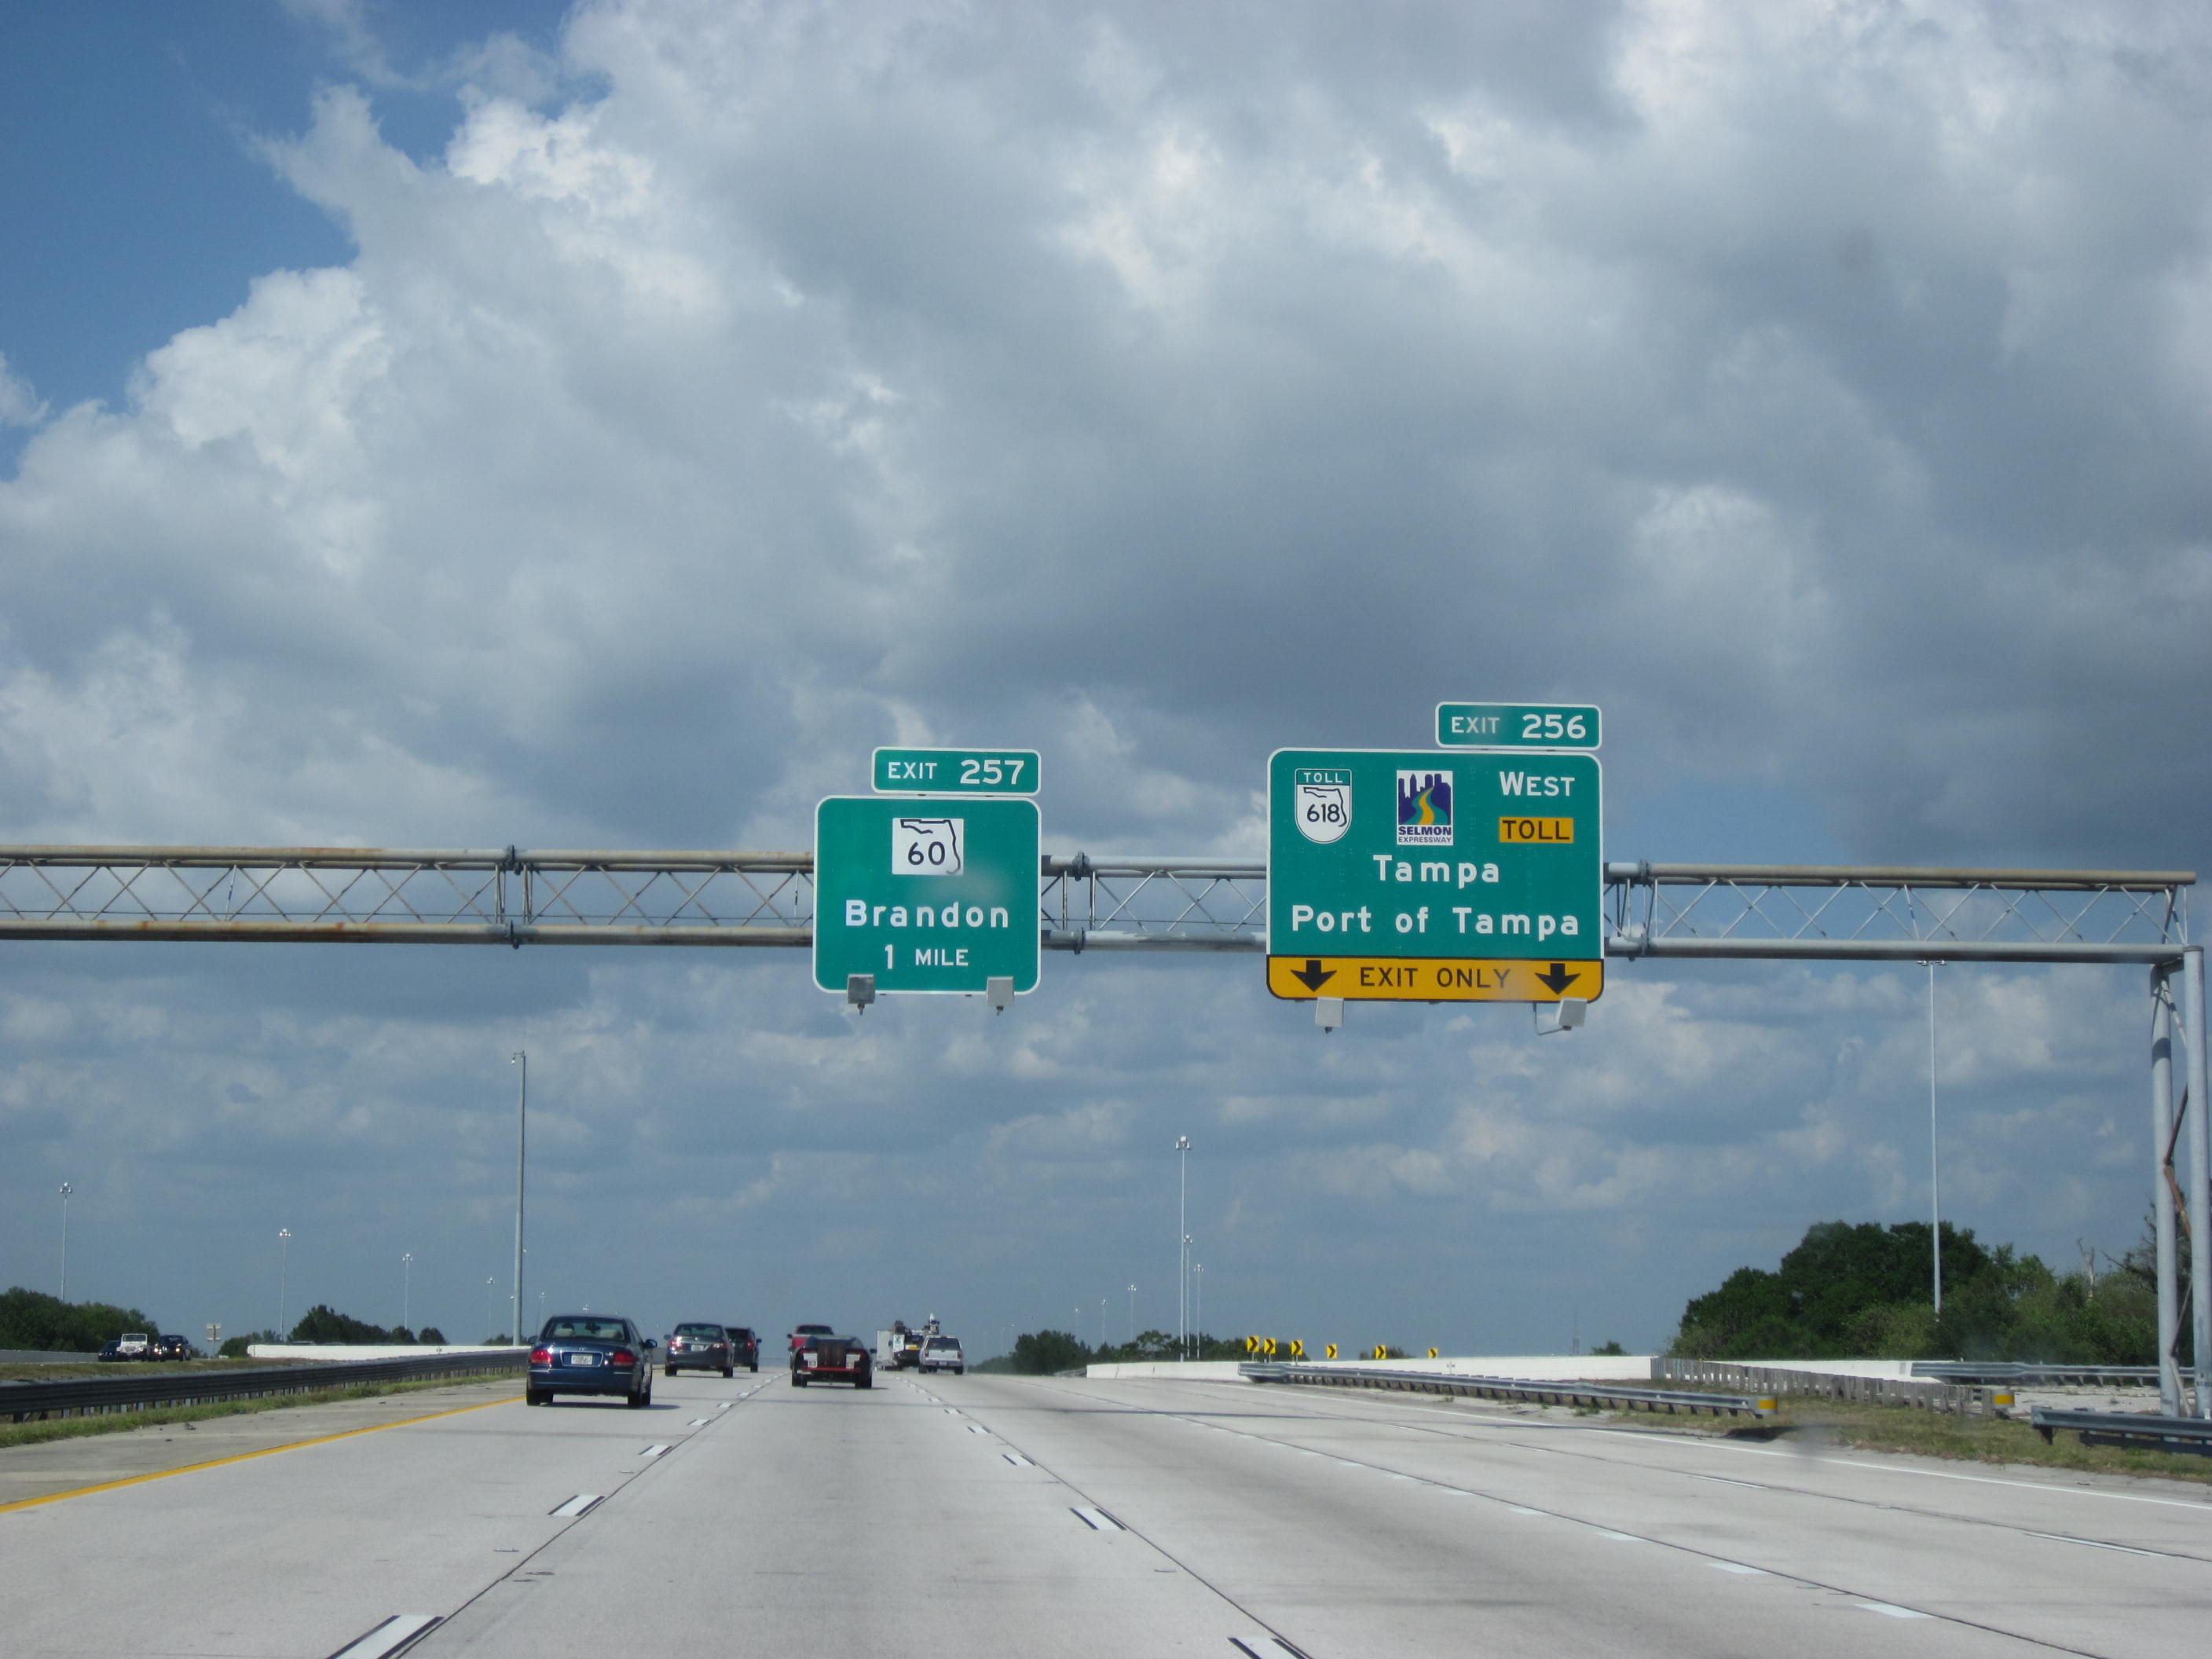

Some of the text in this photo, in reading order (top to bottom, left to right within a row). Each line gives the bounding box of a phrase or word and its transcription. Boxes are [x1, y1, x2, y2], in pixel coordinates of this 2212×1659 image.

[1451, 713, 1587, 739] EXIT 256
[888, 759, 1024, 785] EXIT 257
[1303, 772, 1343, 783] TOLL
[1499, 771, 1576, 797] WEST
[1306, 803, 1340, 823] 618
[1398, 826, 1452, 836] SELMON
[1502, 819, 1570, 840] TOLL
[907, 840, 946, 866] 60
[1372, 854, 1500, 889] Tampa
[845, 899, 1009, 928] Brandon
[1291, 904, 1579, 942] Port of Tampa
[884, 943, 969, 969] 1 MILE
[1360, 966, 1511, 988] EXIT ONLY
